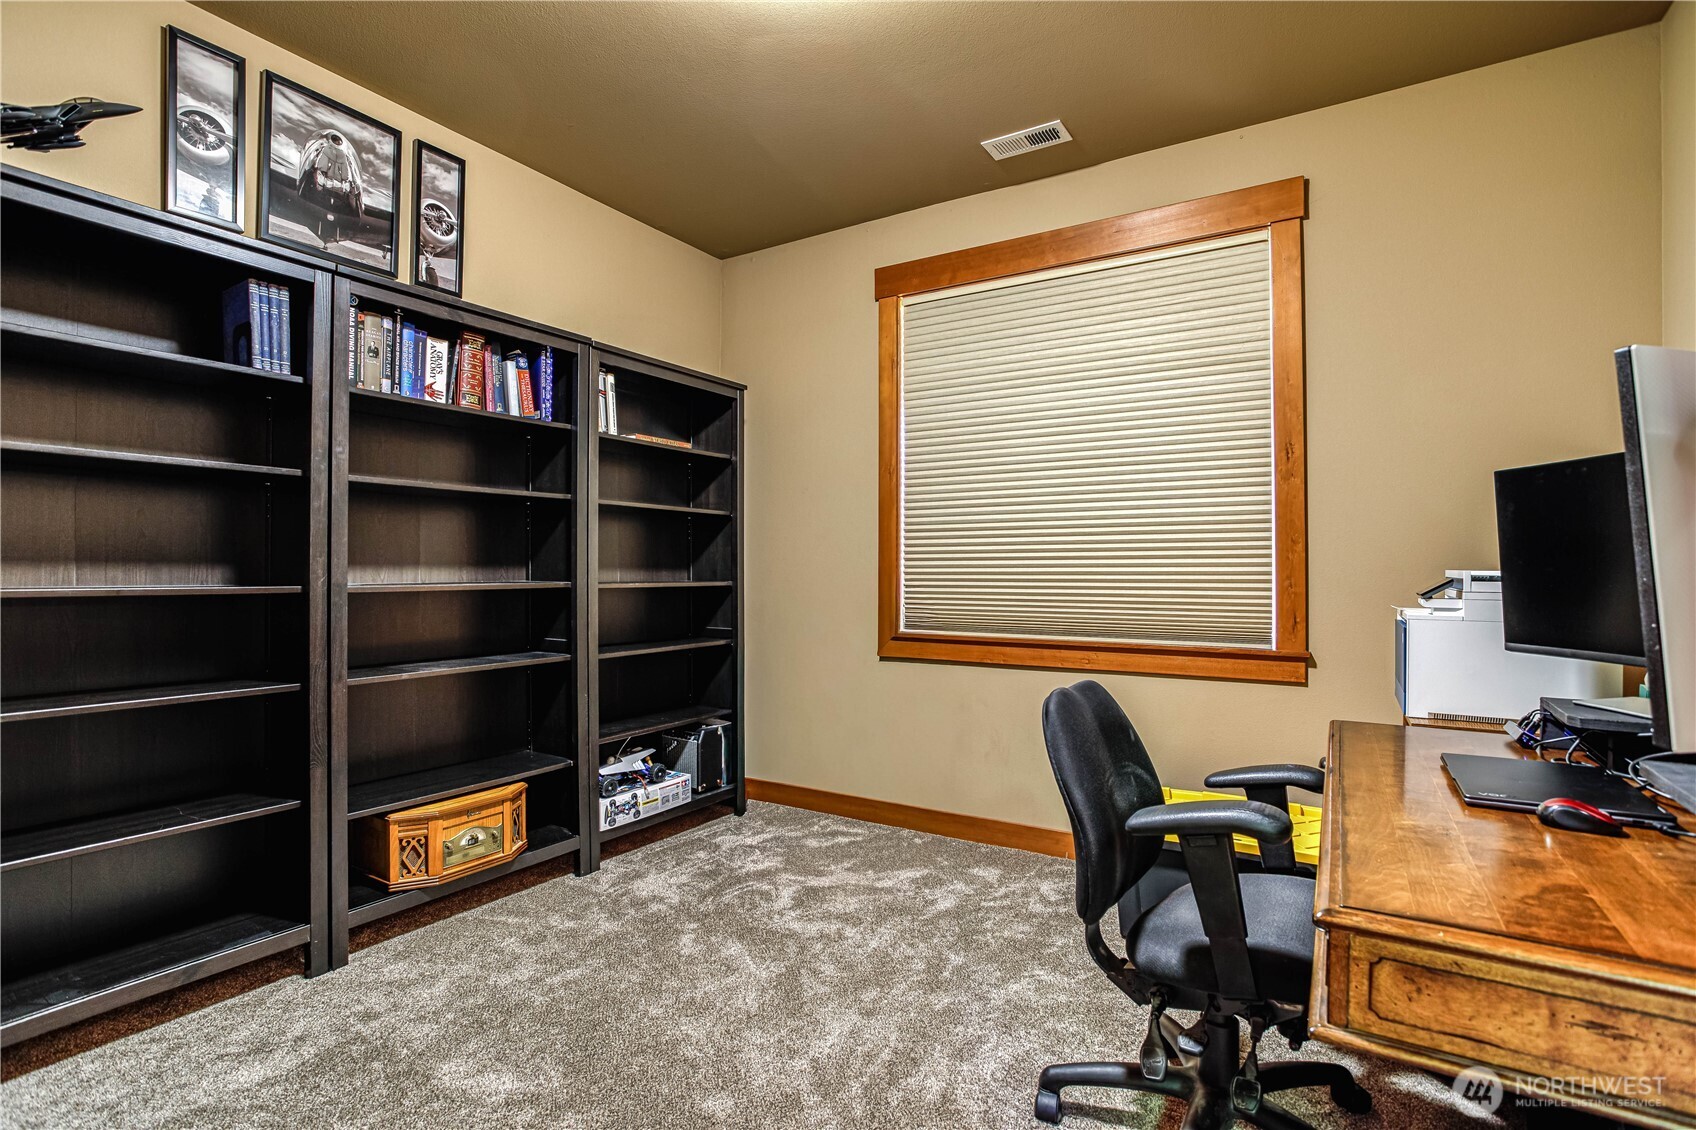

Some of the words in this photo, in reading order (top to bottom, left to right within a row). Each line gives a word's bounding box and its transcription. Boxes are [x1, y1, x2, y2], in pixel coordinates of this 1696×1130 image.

[429, 343, 437, 380] ANATOMY
[436, 351, 444, 375] GRAY'S
[524, 373, 534, 412] DICTIONARY
